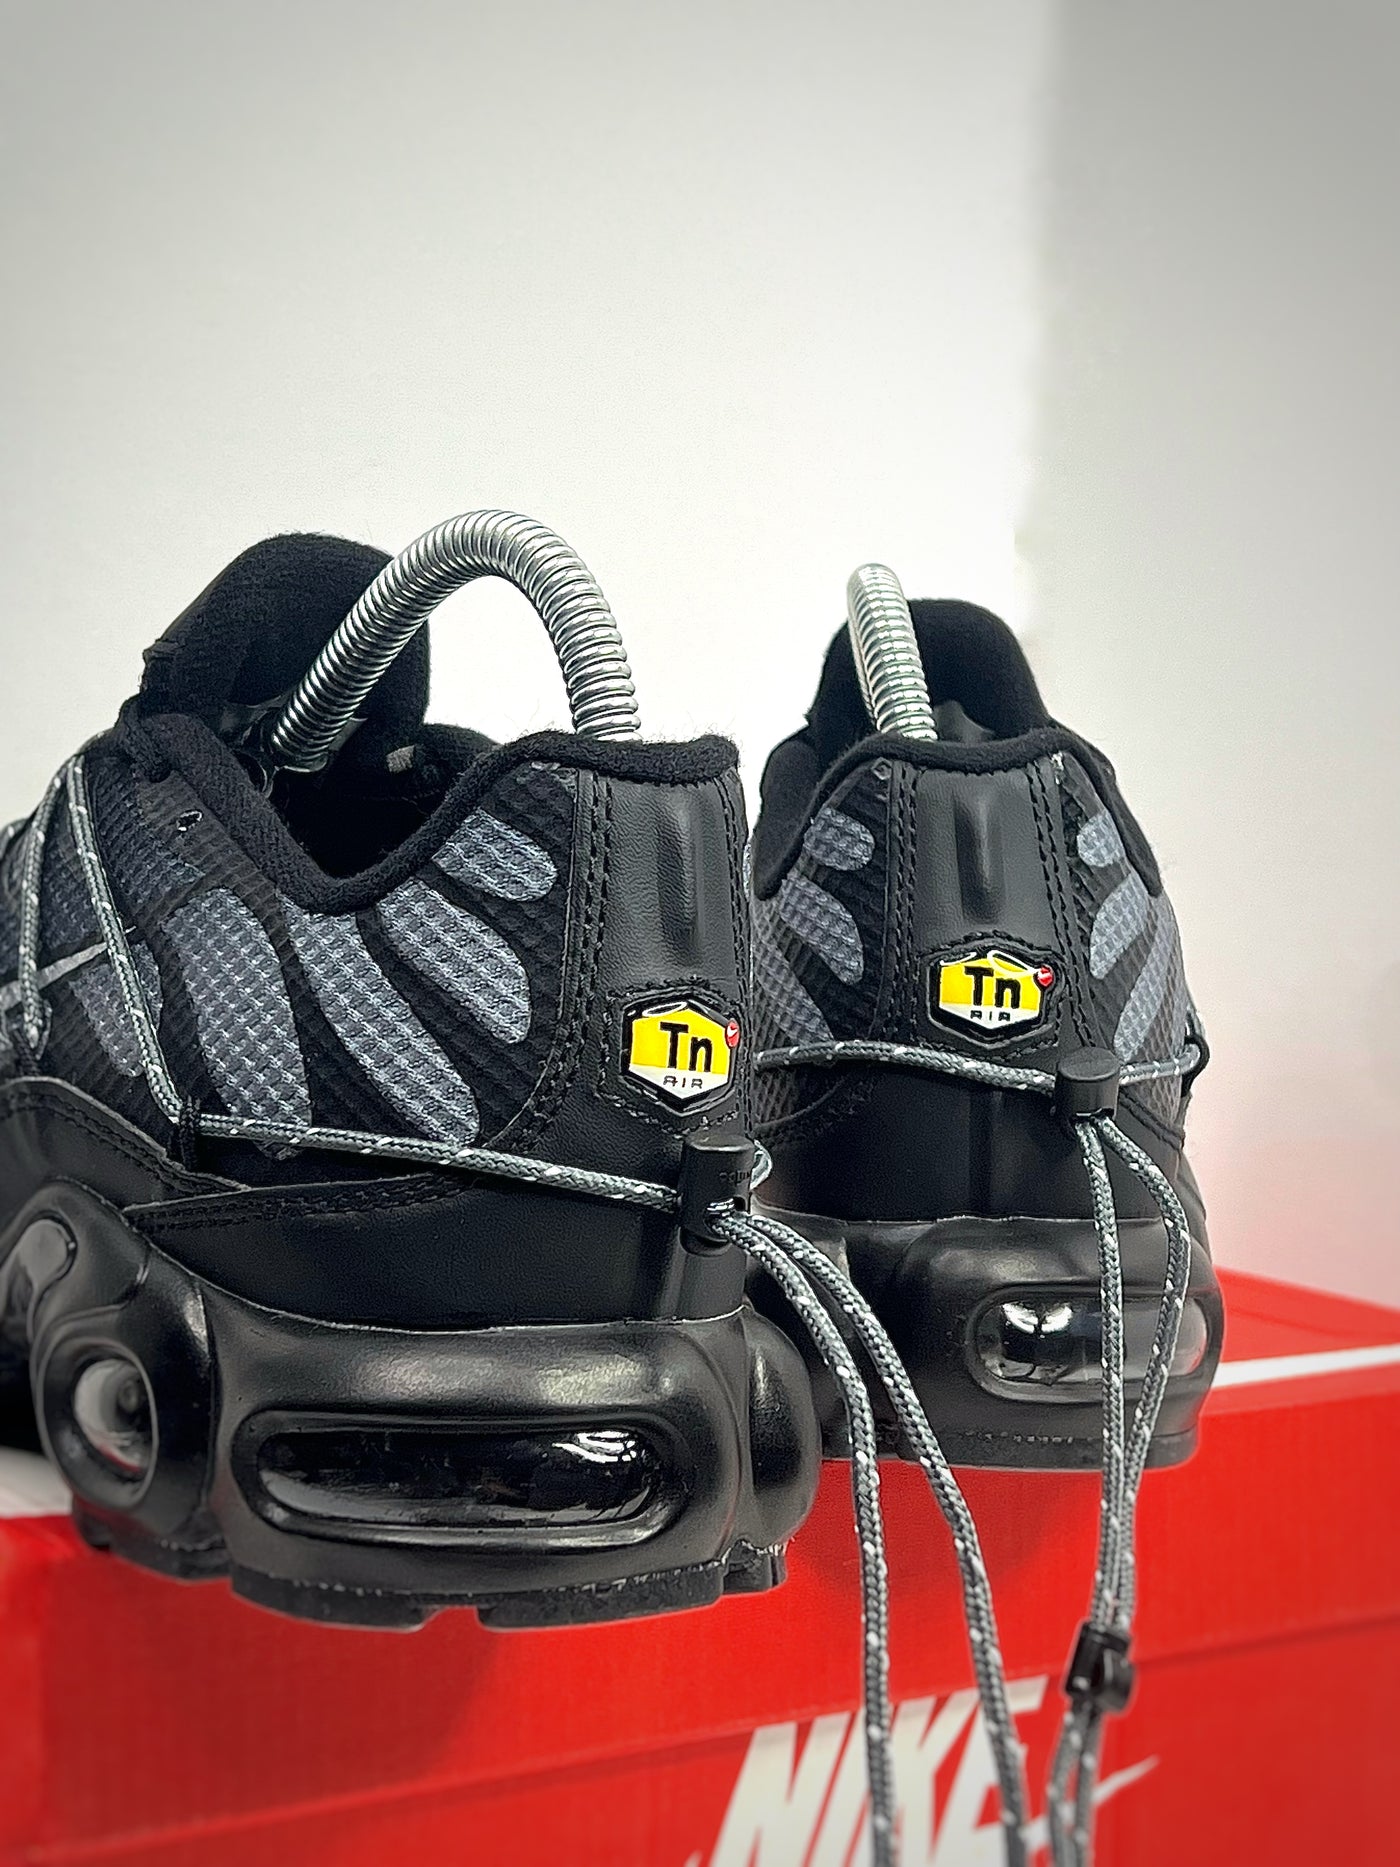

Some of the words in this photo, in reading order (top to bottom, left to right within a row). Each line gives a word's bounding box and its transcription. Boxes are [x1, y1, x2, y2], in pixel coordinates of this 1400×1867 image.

[964, 966, 1021, 1009] Tn
[970, 1010, 1011, 1022] AIR
[660, 1021, 713, 1073] Tn
[663, 1075, 703, 1089] AIR
